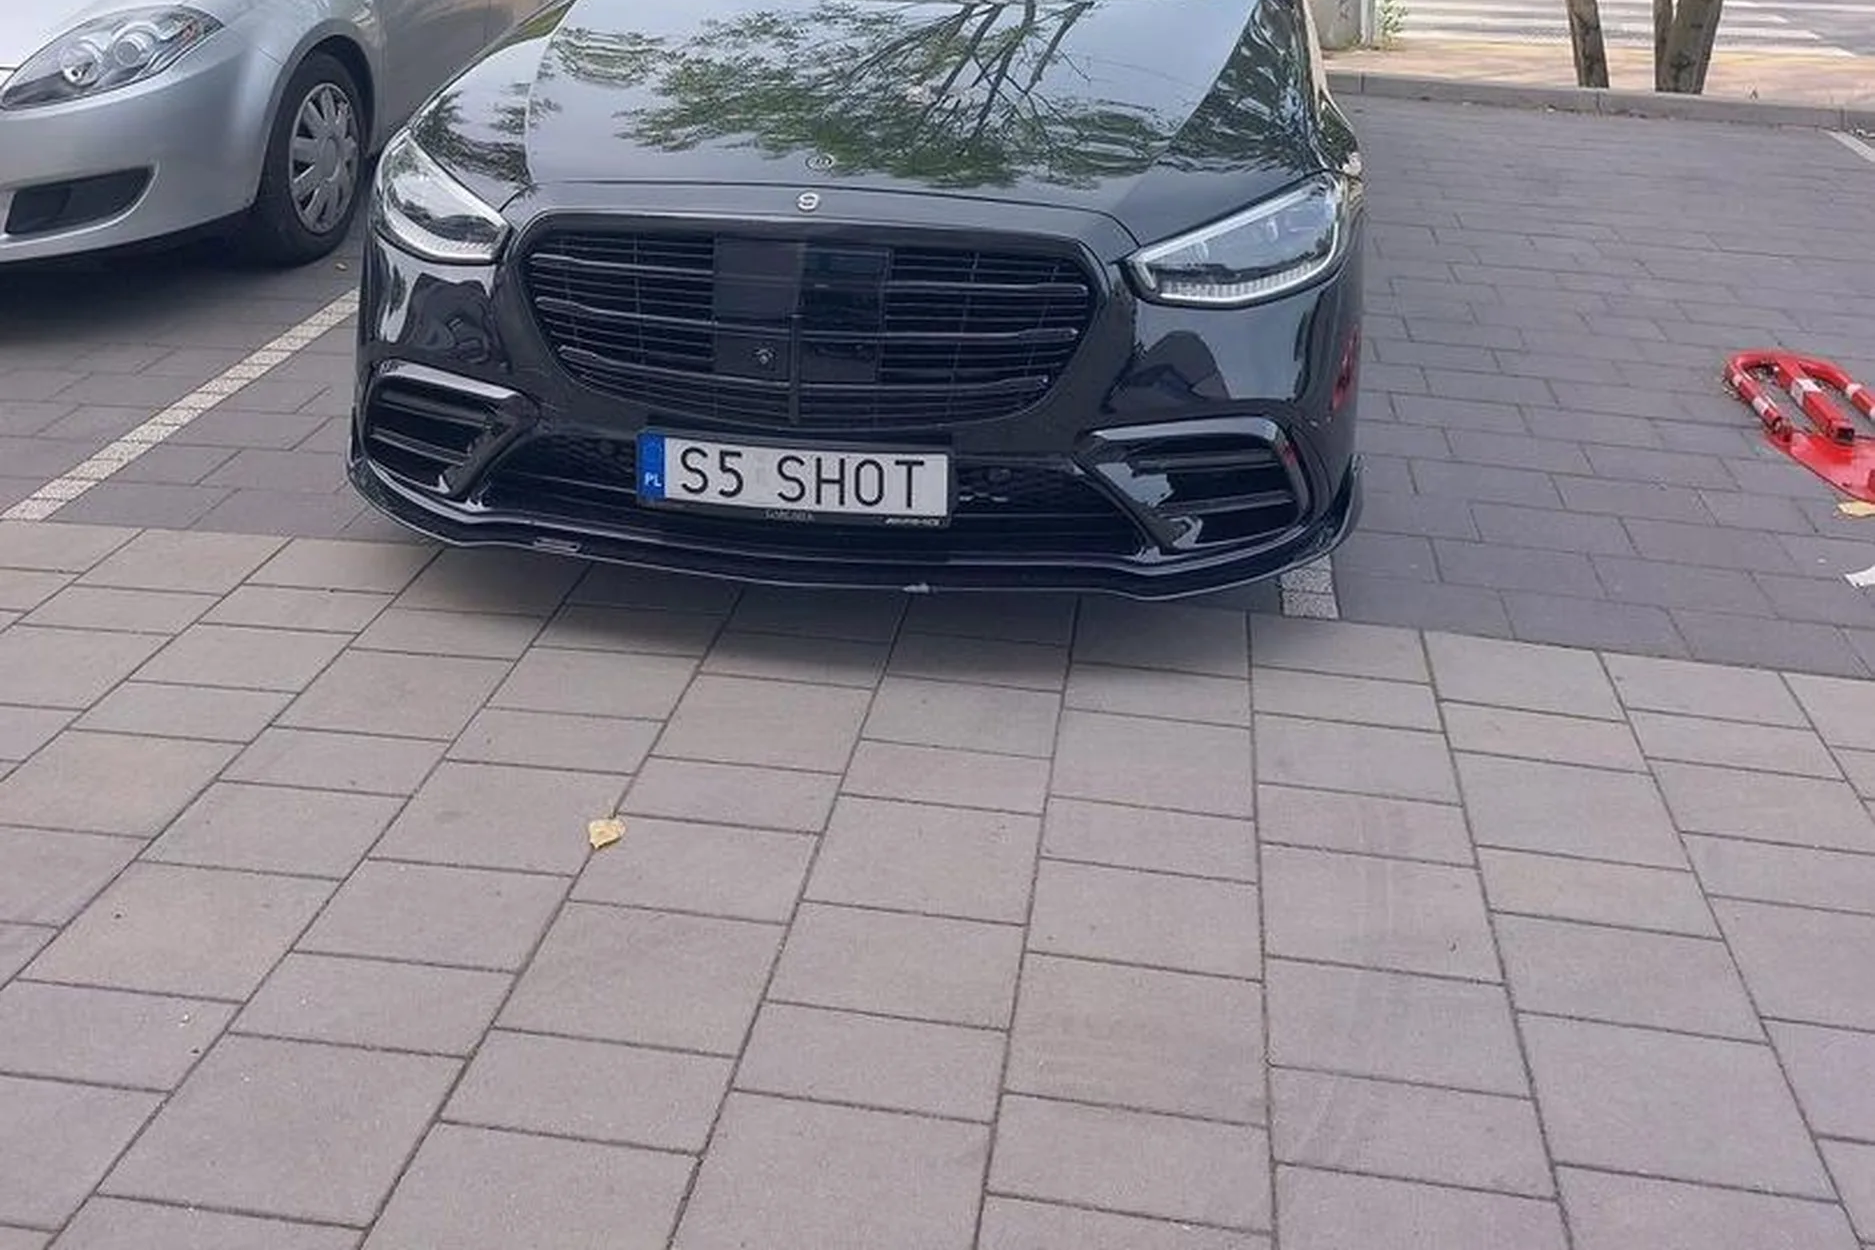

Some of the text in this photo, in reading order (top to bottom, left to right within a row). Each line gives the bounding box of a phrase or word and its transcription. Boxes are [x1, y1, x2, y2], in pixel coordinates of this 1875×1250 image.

[644, 472, 662, 487] PL
[680, 447, 925, 508] S5 SHOT
